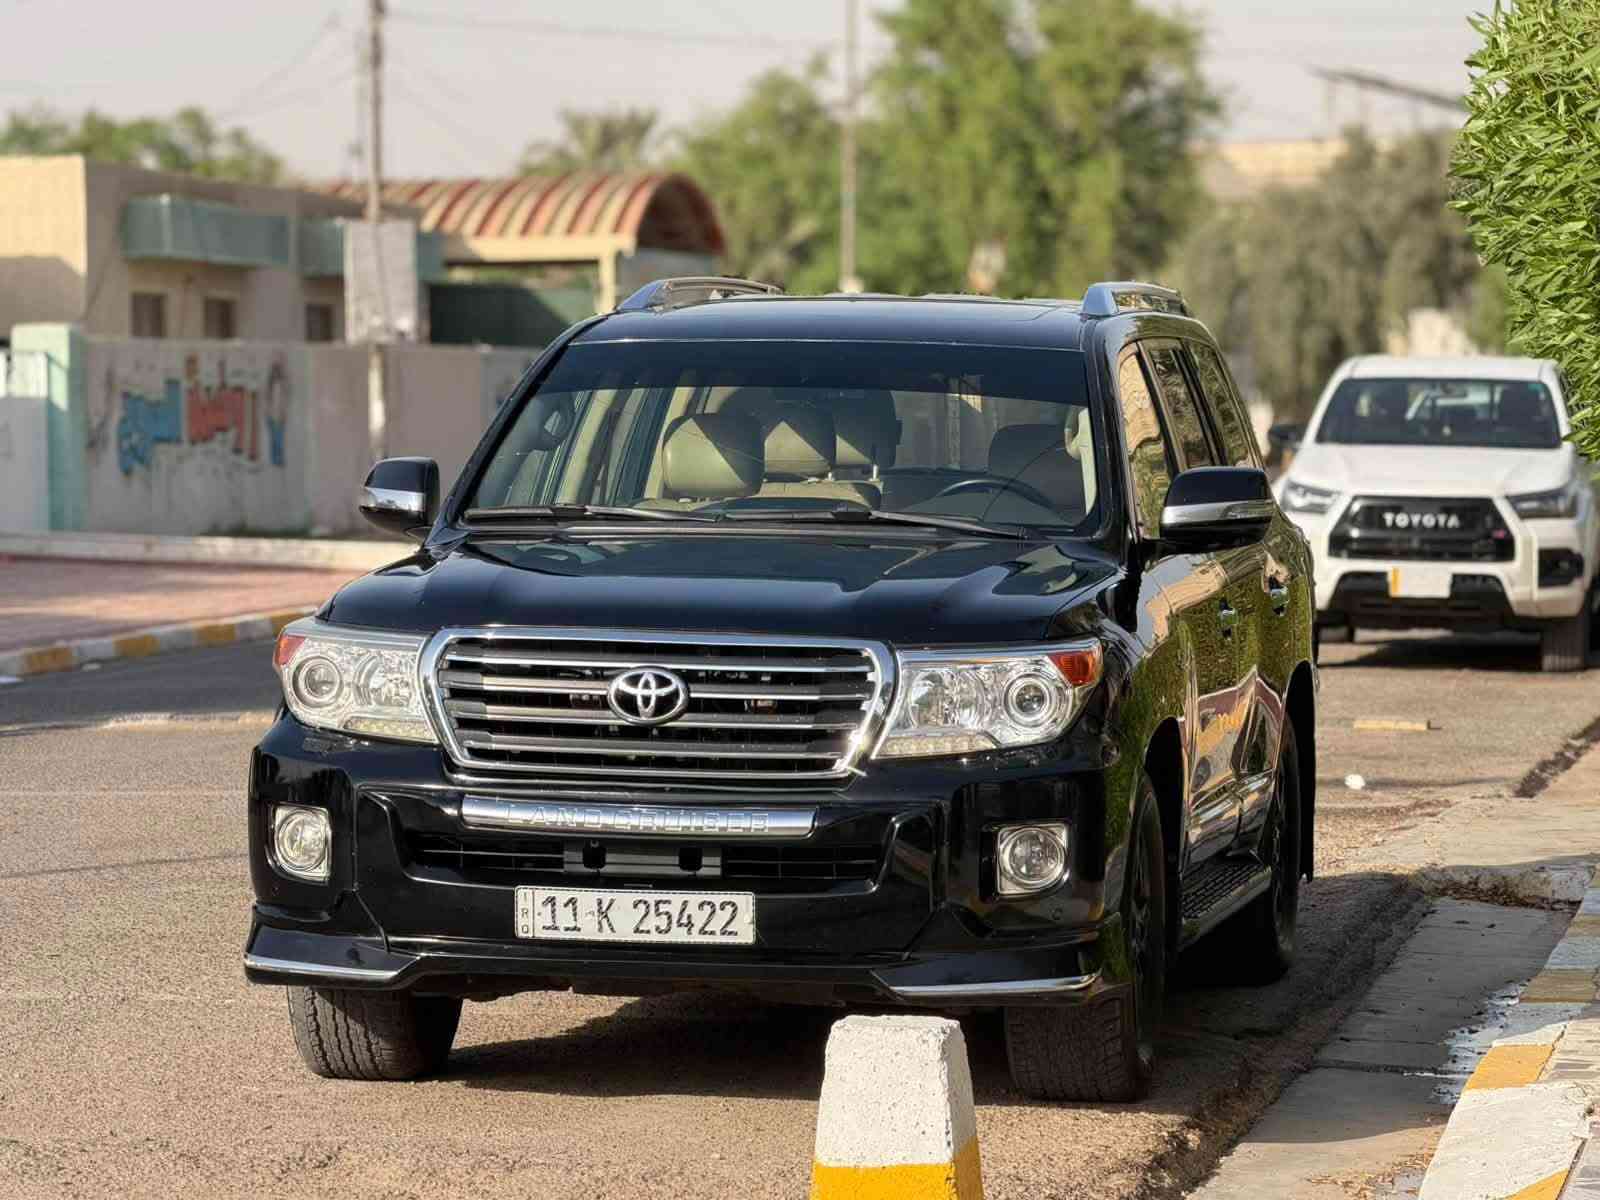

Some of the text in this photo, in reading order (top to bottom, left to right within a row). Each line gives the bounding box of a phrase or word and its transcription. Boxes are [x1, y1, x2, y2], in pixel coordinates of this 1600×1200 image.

[1382, 511, 1460, 528] TOYOTA
[507, 804, 769, 832] LAND CRUISER
[542, 896, 738, 936] 11 K 25422
